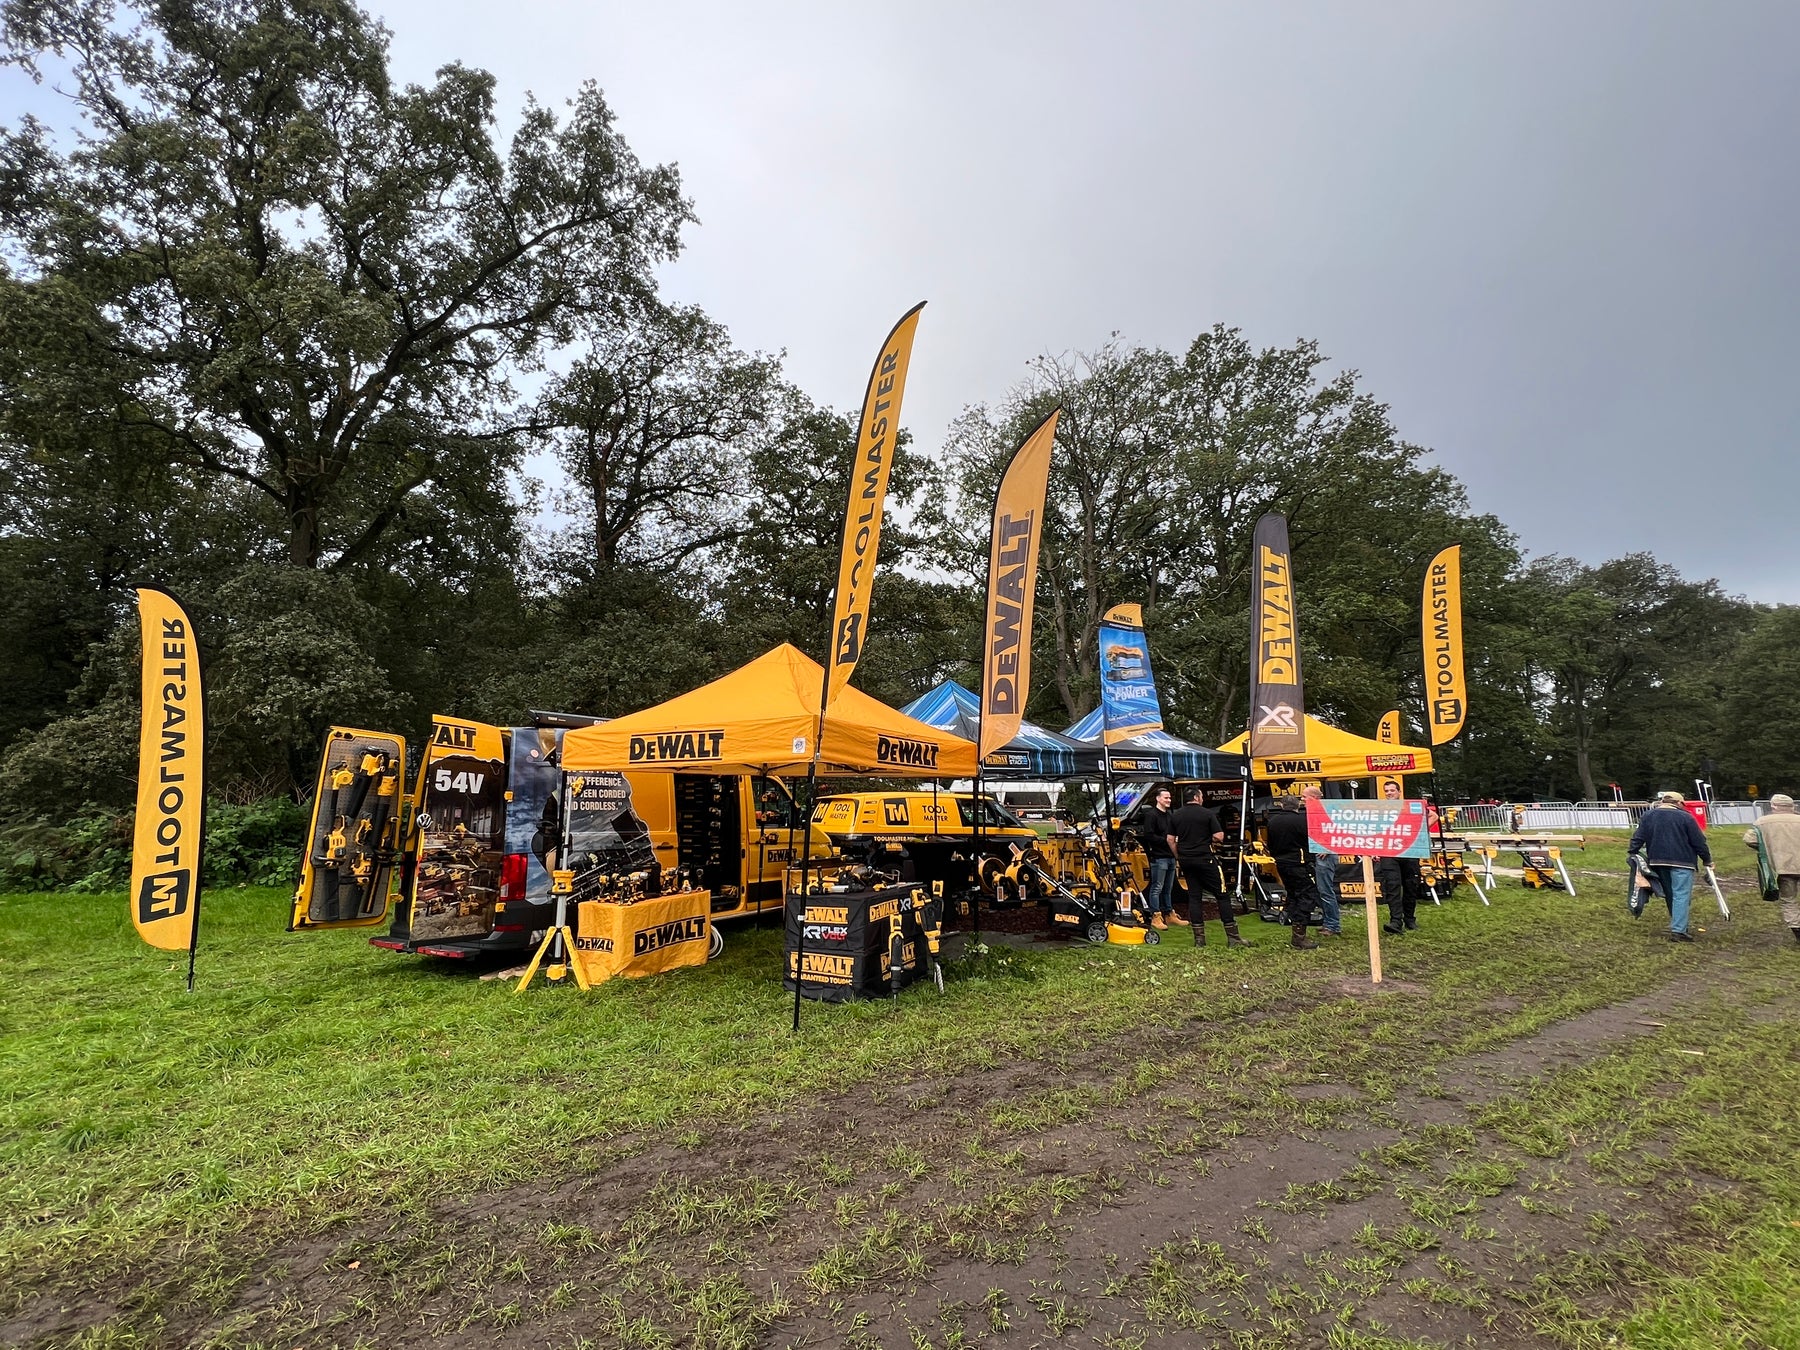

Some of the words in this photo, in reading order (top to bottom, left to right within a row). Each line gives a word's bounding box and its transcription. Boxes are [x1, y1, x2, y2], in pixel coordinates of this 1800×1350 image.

[1432, 562, 1455, 697] TOOLMASTER
[1115, 688, 1148, 701] POWER
[1257, 704, 1298, 727] XR
[629, 732, 724, 761] DEWALT
[876, 736, 940, 768] DEWALT
[1265, 760, 1321, 773] DEWALT
[435, 769, 484, 794] 54V
[598, 789, 626, 799] CORDED
[832, 803, 851, 812] TOOL
[921, 805, 948, 814] TOOL
[1330, 809, 1381, 821] HOME
[1383, 810, 1399, 821] IS
[1321, 822, 1378, 836] WHERE
[1379, 824, 1412, 837] THE
[1330, 836, 1384, 849] HORSE
[1387, 838, 1404, 850] IS
[635, 917, 706, 956] DEWALT
[821, 926, 848, 934] FLEX
